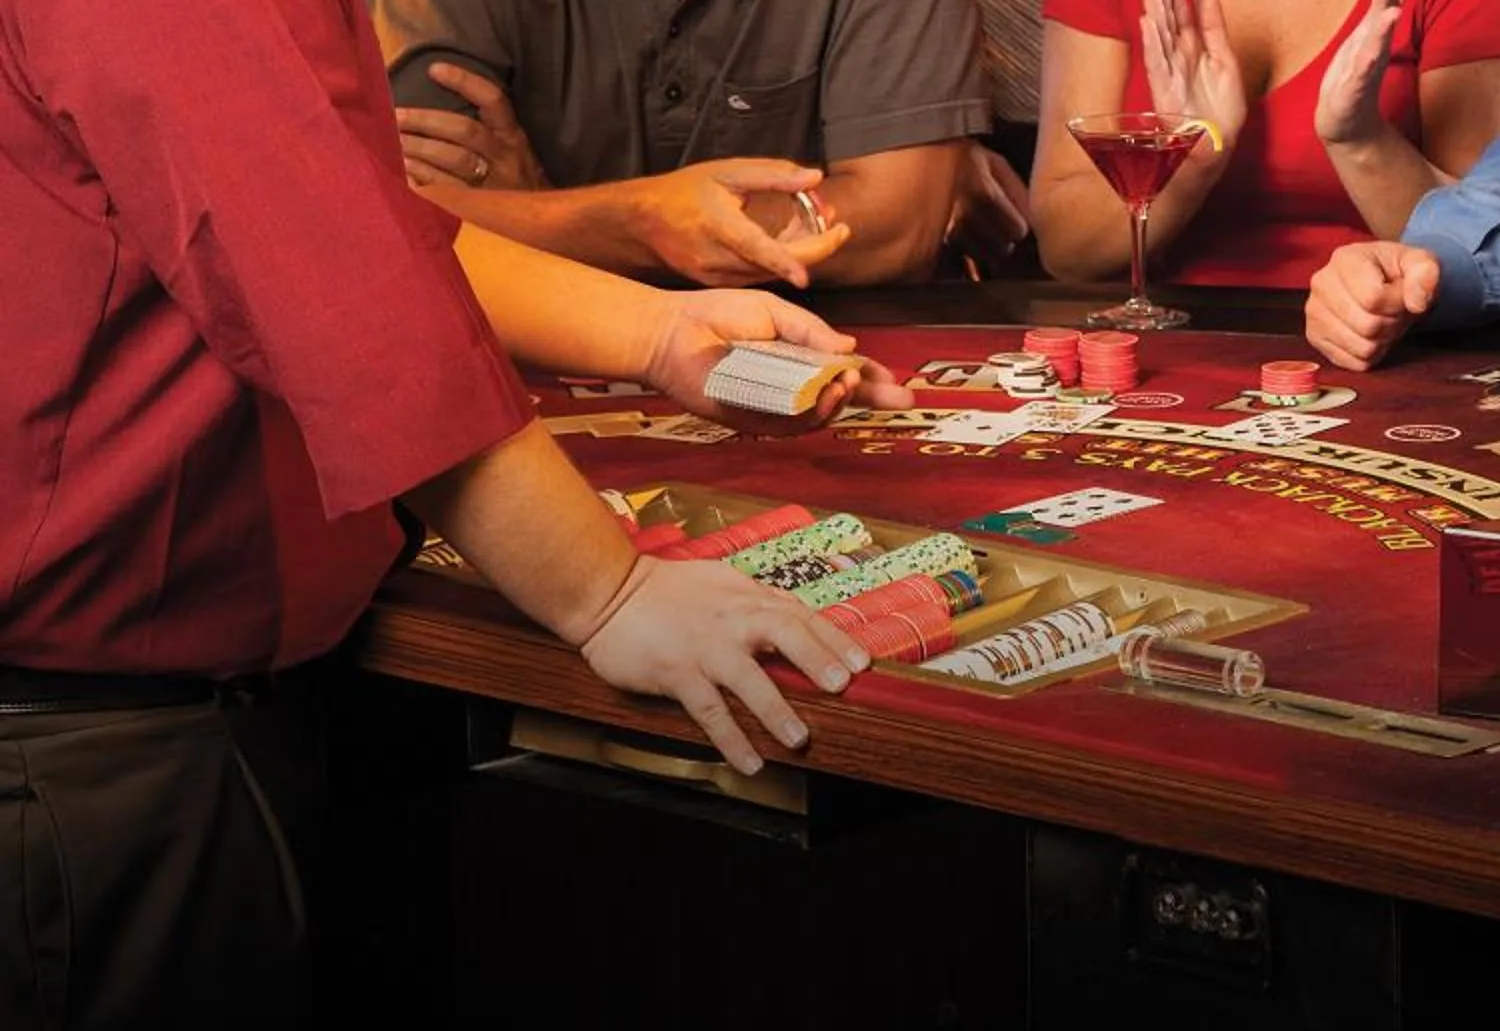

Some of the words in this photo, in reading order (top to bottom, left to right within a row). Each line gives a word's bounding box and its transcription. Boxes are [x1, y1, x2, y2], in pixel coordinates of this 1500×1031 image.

[860, 441, 897, 455] 2
[917, 441, 1000, 458] TO
[1074, 451, 1216, 478] PAYS
[1210, 470, 1437, 552] BLACKJACK
